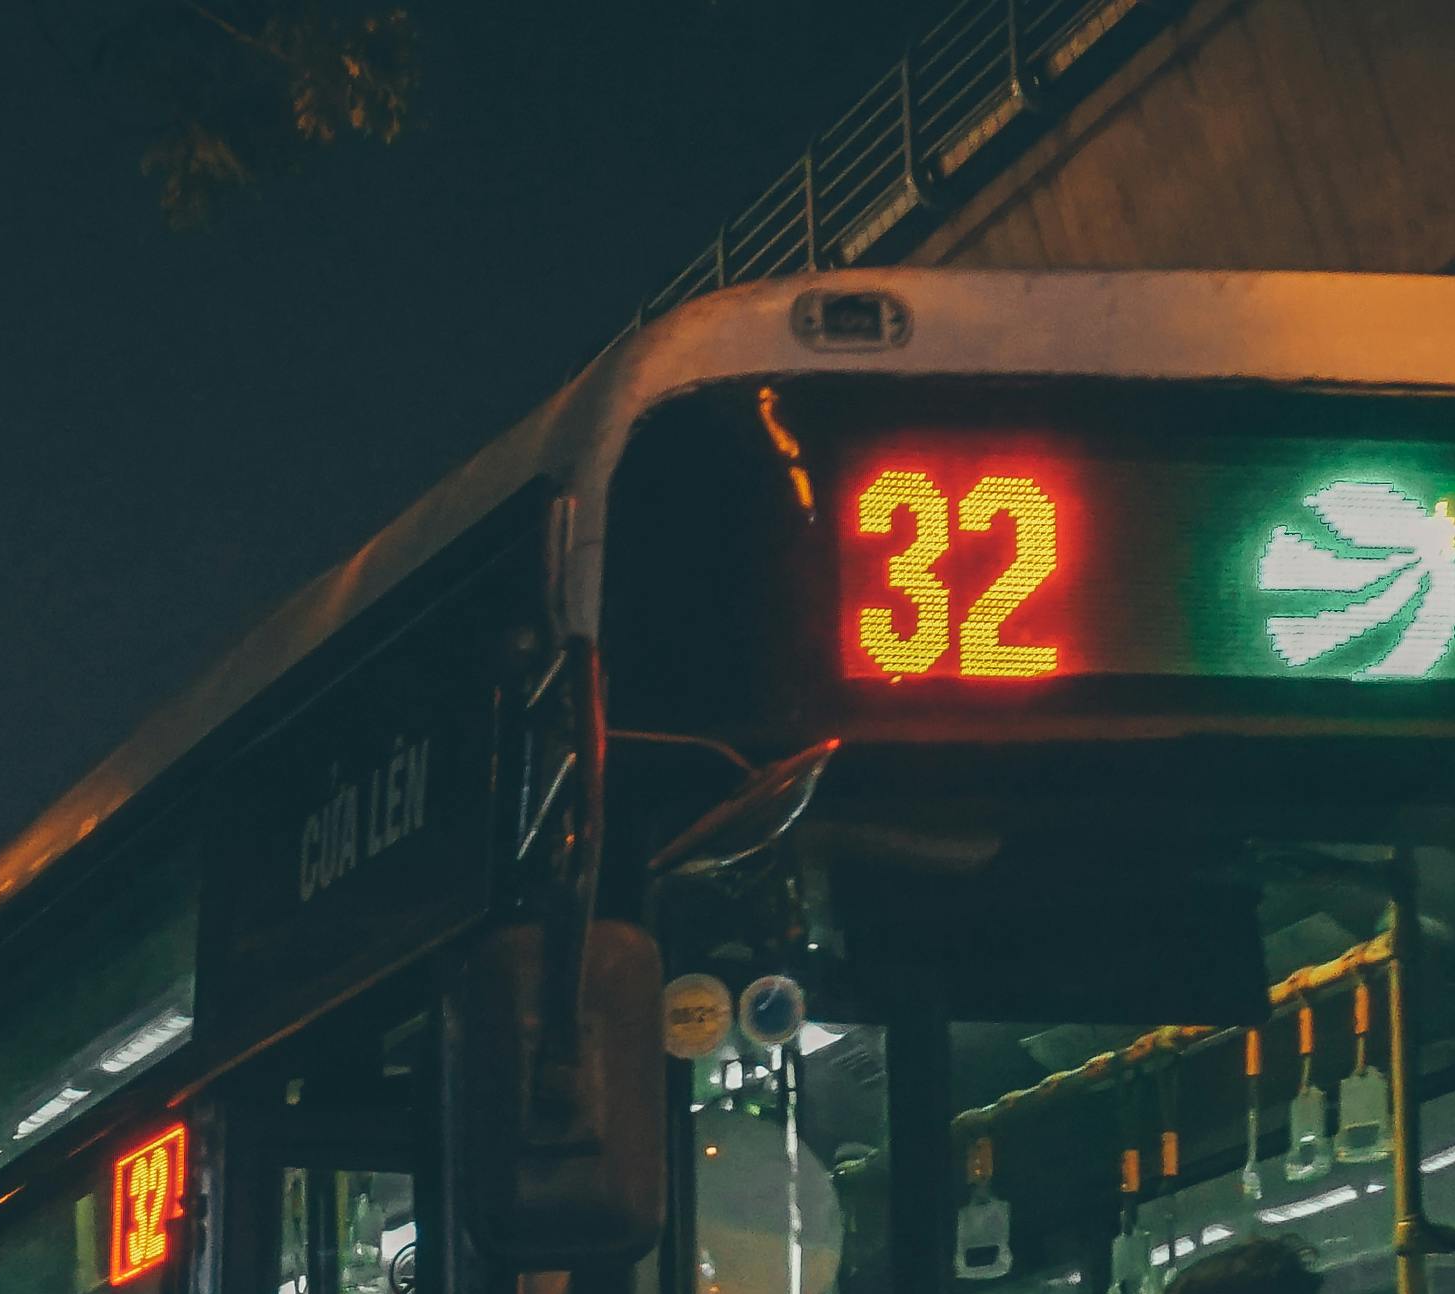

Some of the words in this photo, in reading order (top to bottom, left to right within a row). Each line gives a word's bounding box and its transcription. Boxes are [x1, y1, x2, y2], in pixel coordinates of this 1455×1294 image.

[858, 471, 1058, 677] 32
[366, 734, 430, 858] LÊN
[129, 1147, 168, 1266] 32
